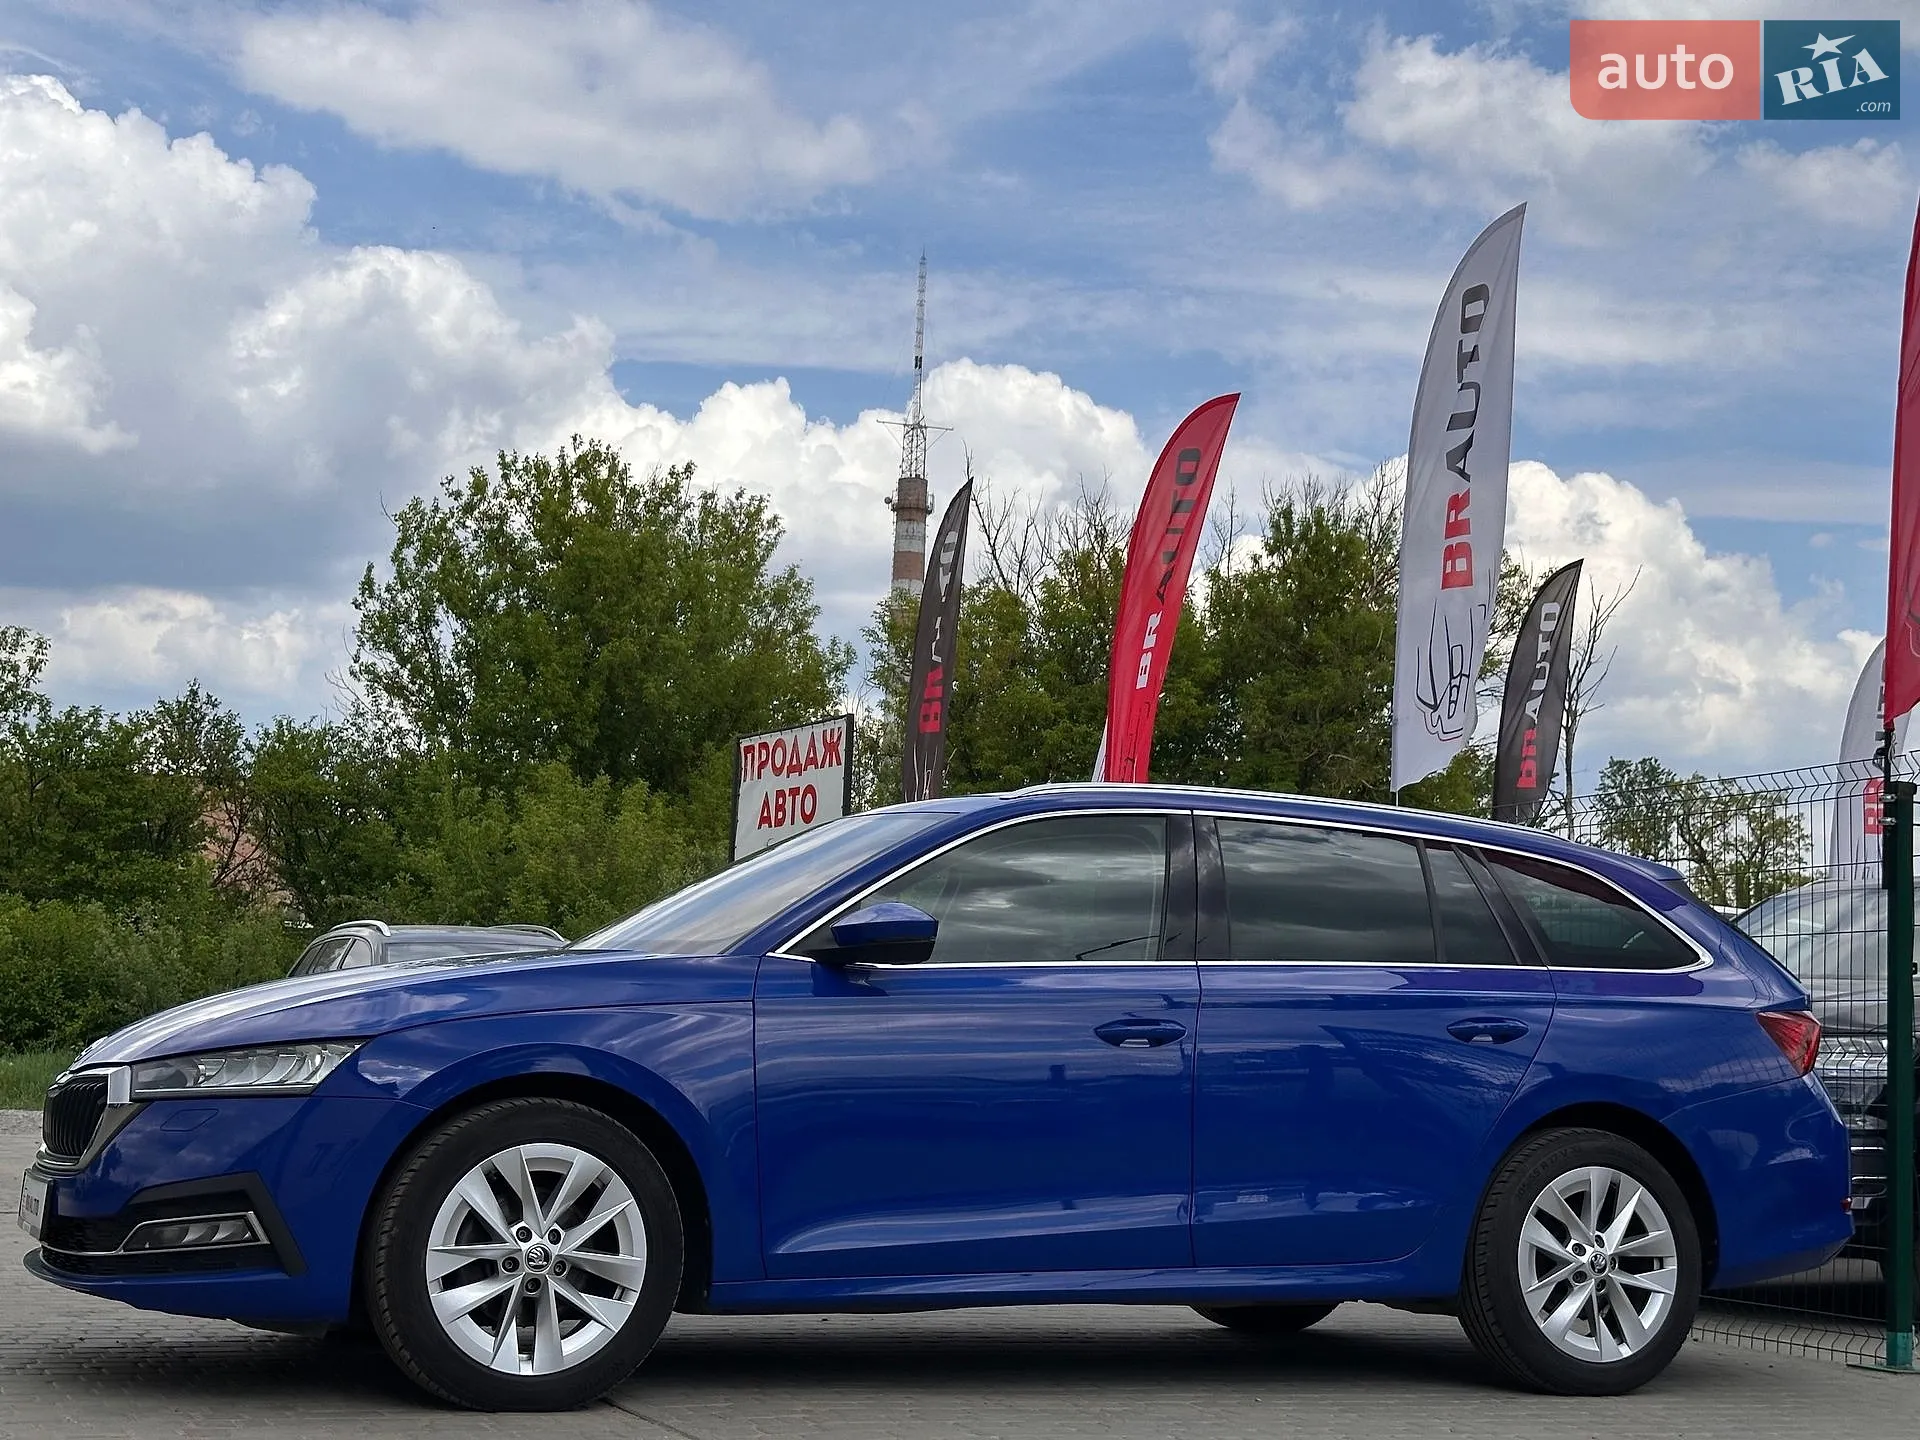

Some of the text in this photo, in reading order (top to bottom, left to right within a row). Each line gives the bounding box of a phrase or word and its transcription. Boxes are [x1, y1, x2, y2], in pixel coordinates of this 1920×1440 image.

[1441, 283, 1490, 589] BRAUTO
[743, 727, 842, 782] ПРОДАЖ
[757, 784, 817, 830] АВТО
